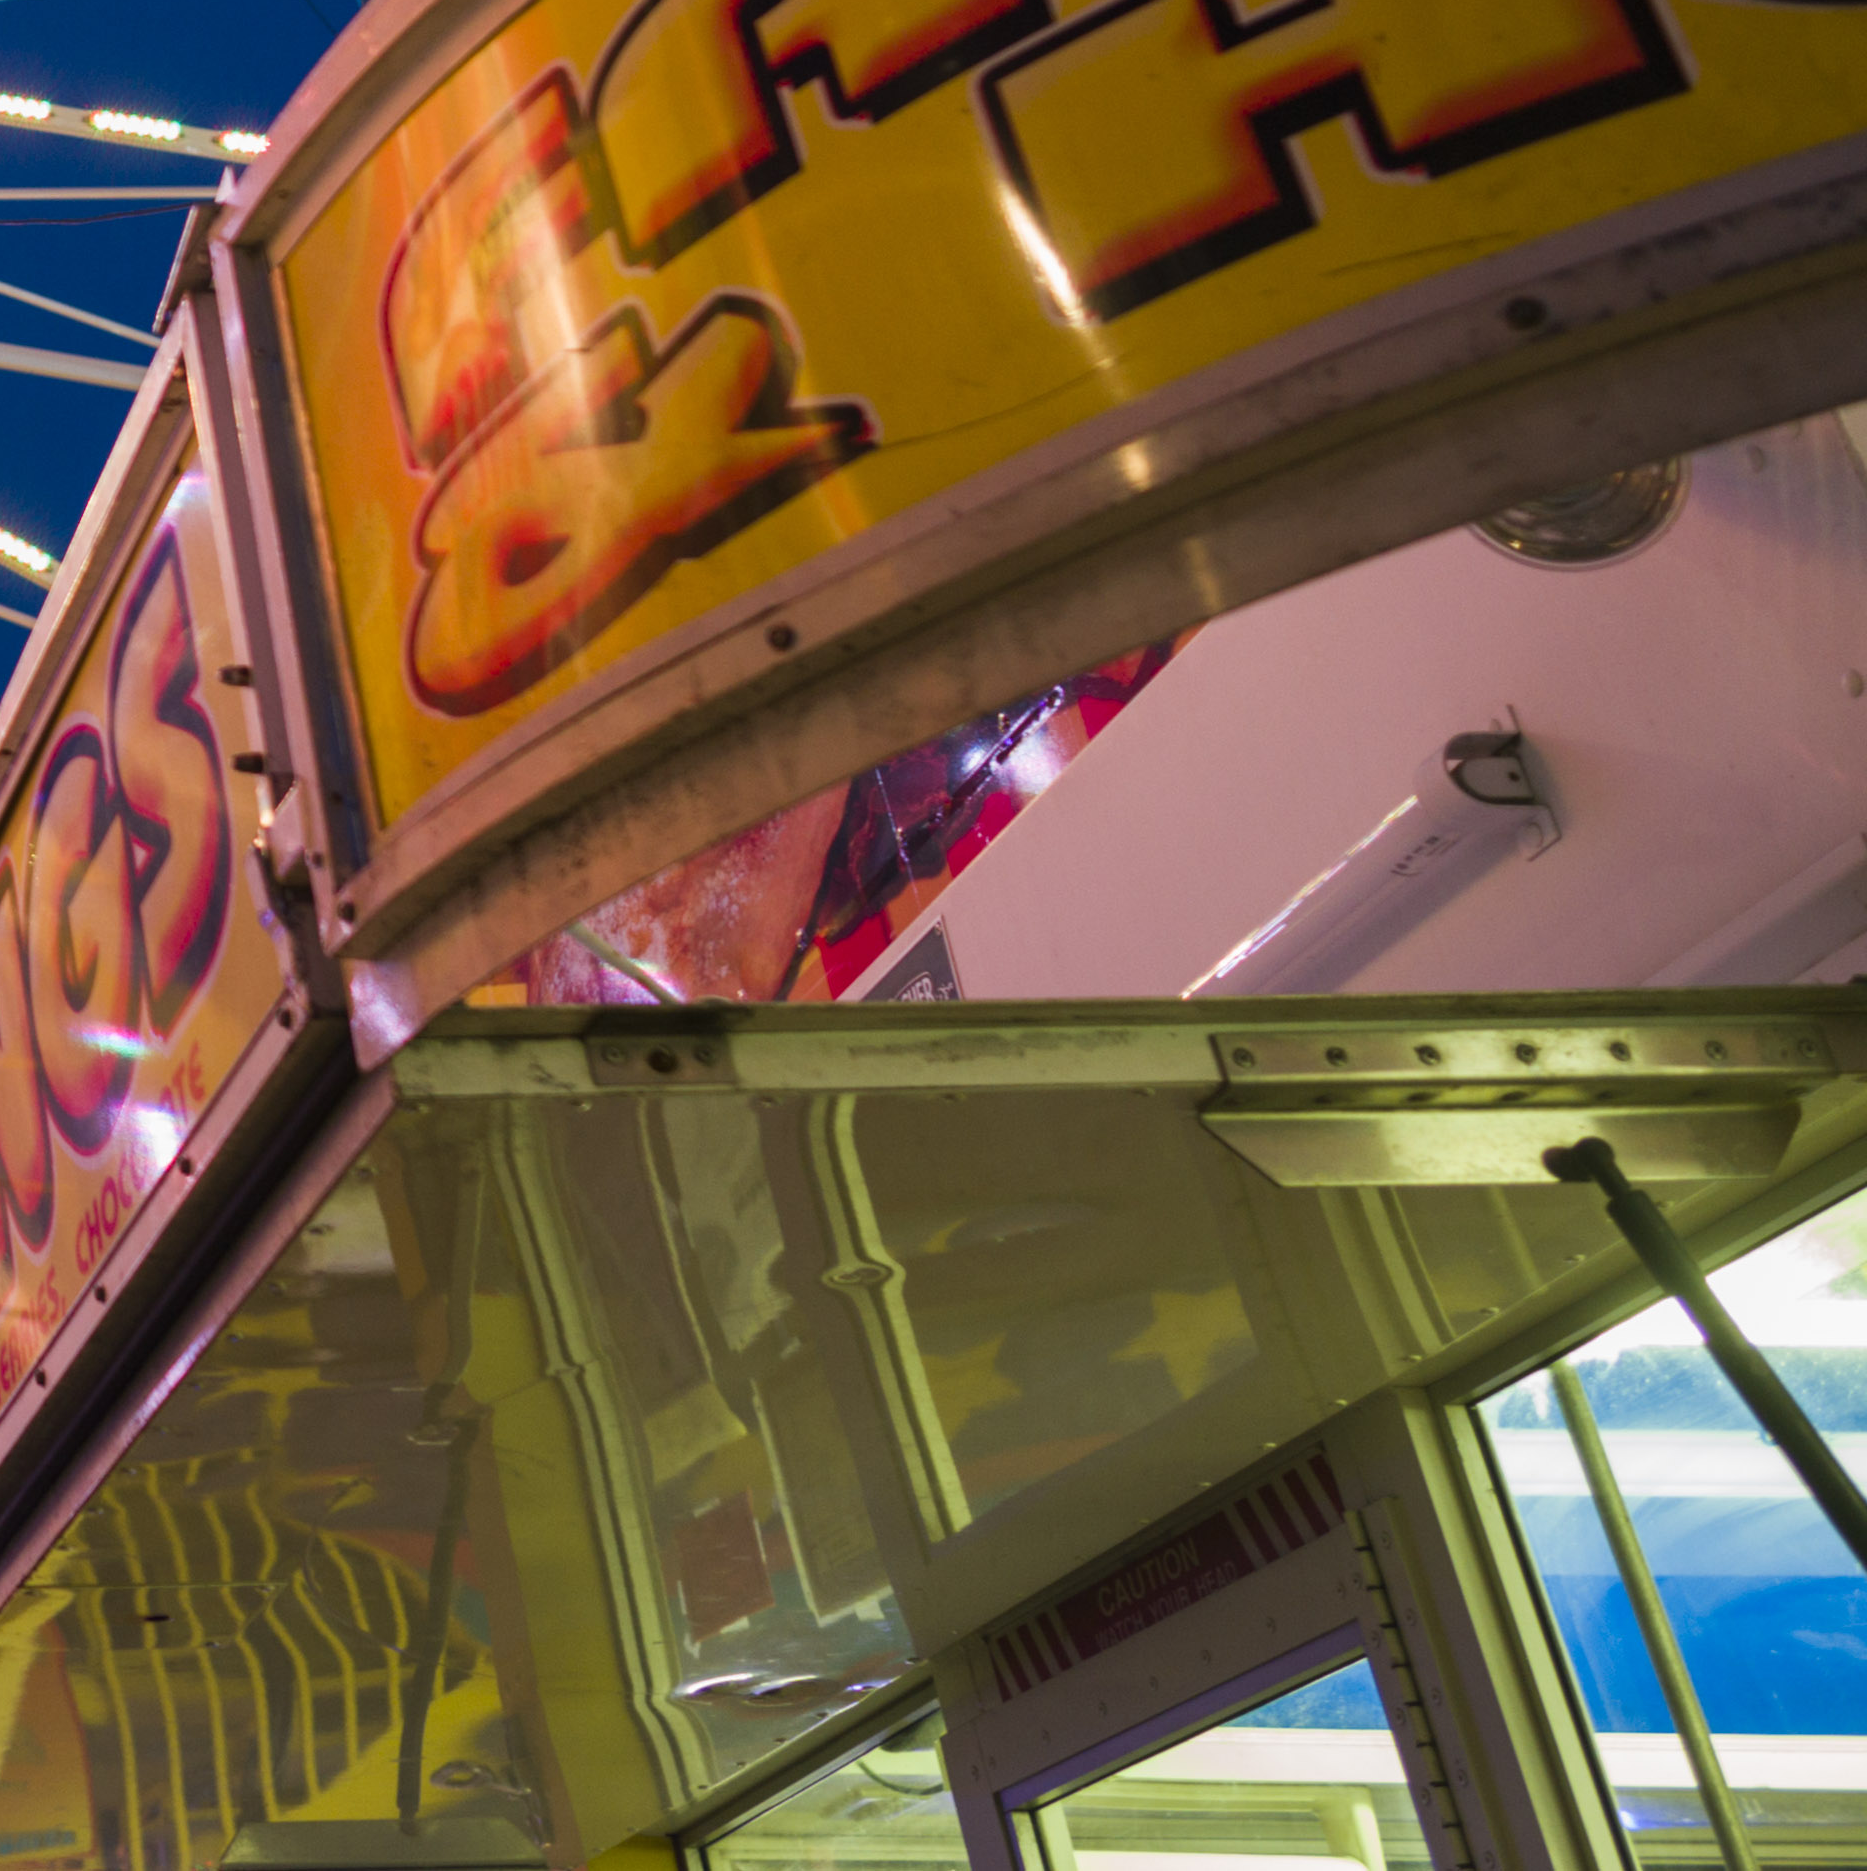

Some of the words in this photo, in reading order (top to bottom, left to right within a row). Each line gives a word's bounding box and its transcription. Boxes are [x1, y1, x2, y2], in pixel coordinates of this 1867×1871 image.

[404, 288, 880, 715] &
[1094, 1598, 1145, 1653] WATCH
[1148, 1585, 1190, 1626] YOUR
[1196, 1560, 1236, 1596] HEAD
[1097, 1537, 1202, 1618] CAUTION
